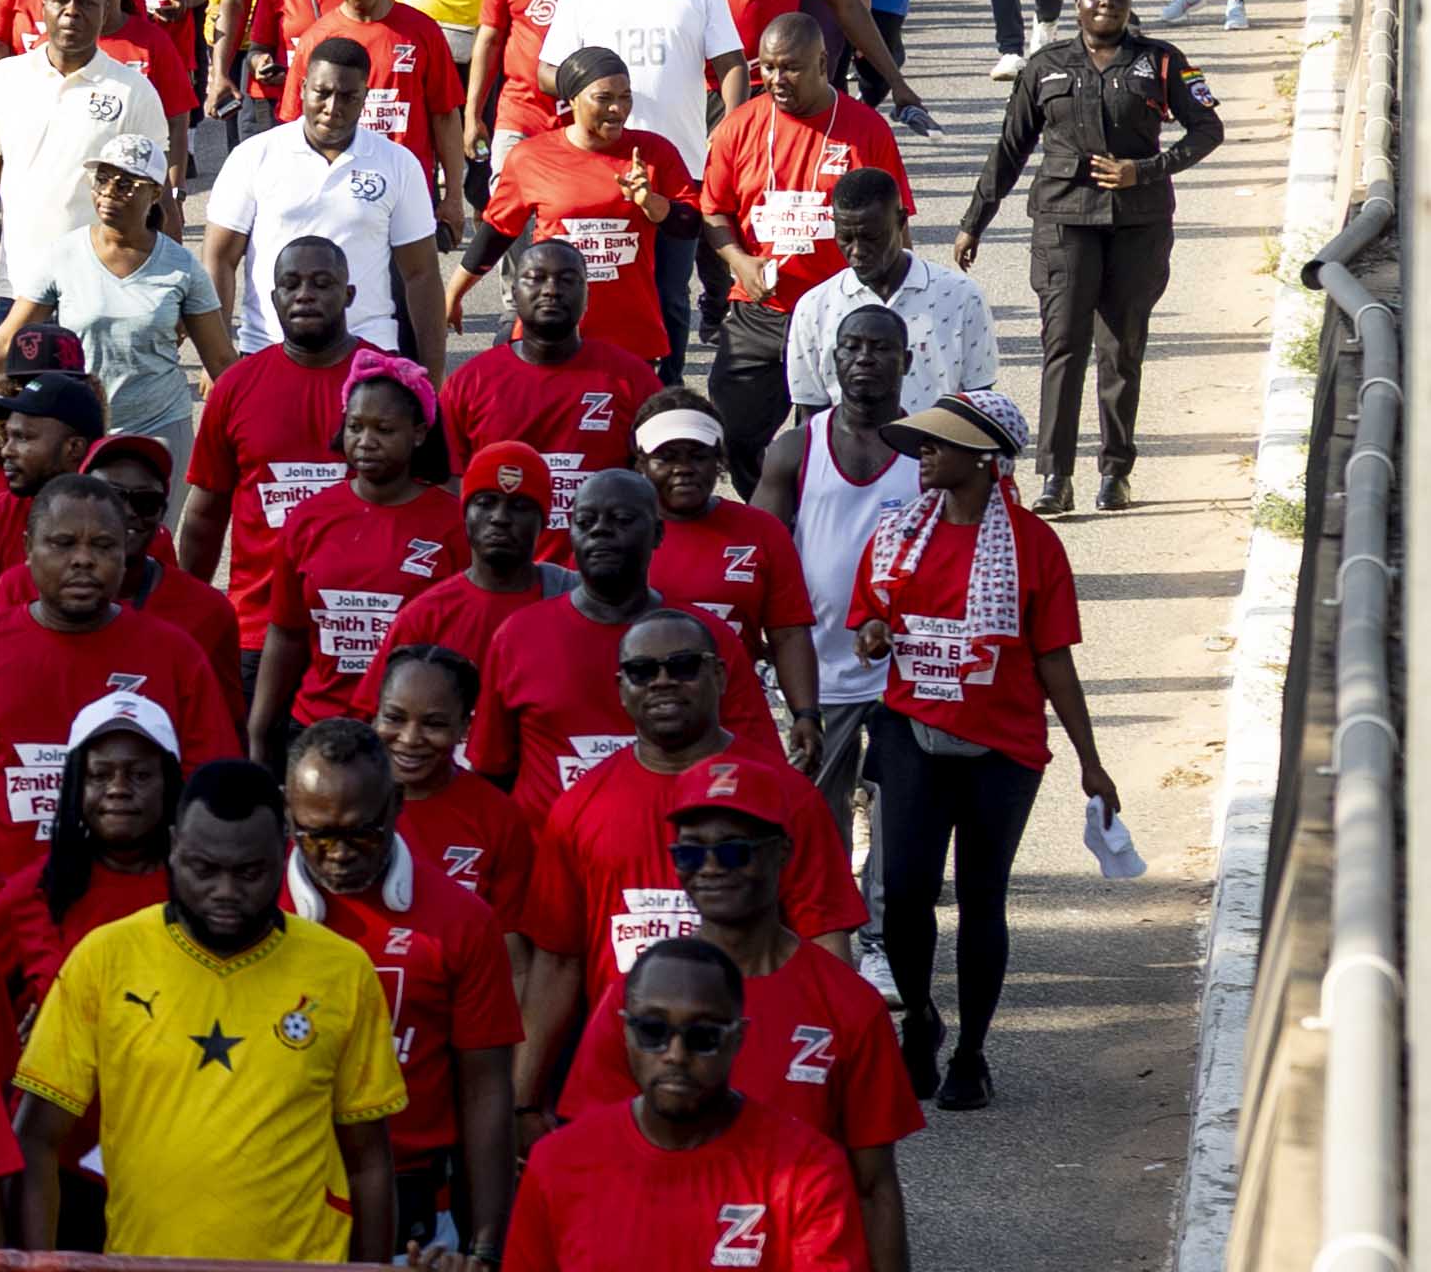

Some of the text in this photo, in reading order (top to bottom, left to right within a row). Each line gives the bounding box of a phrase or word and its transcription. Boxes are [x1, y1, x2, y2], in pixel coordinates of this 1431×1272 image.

[604, 237, 637, 250] Bank
[284, 466, 338, 479] Join the
[334, 594, 390, 609] Join the
[317, 615, 366, 634] Zenith
[894, 642, 944, 658] Zenith
[917, 685, 960, 699] today!
[33, 748, 68, 763] Join
[616, 920, 670, 942] Zenith
